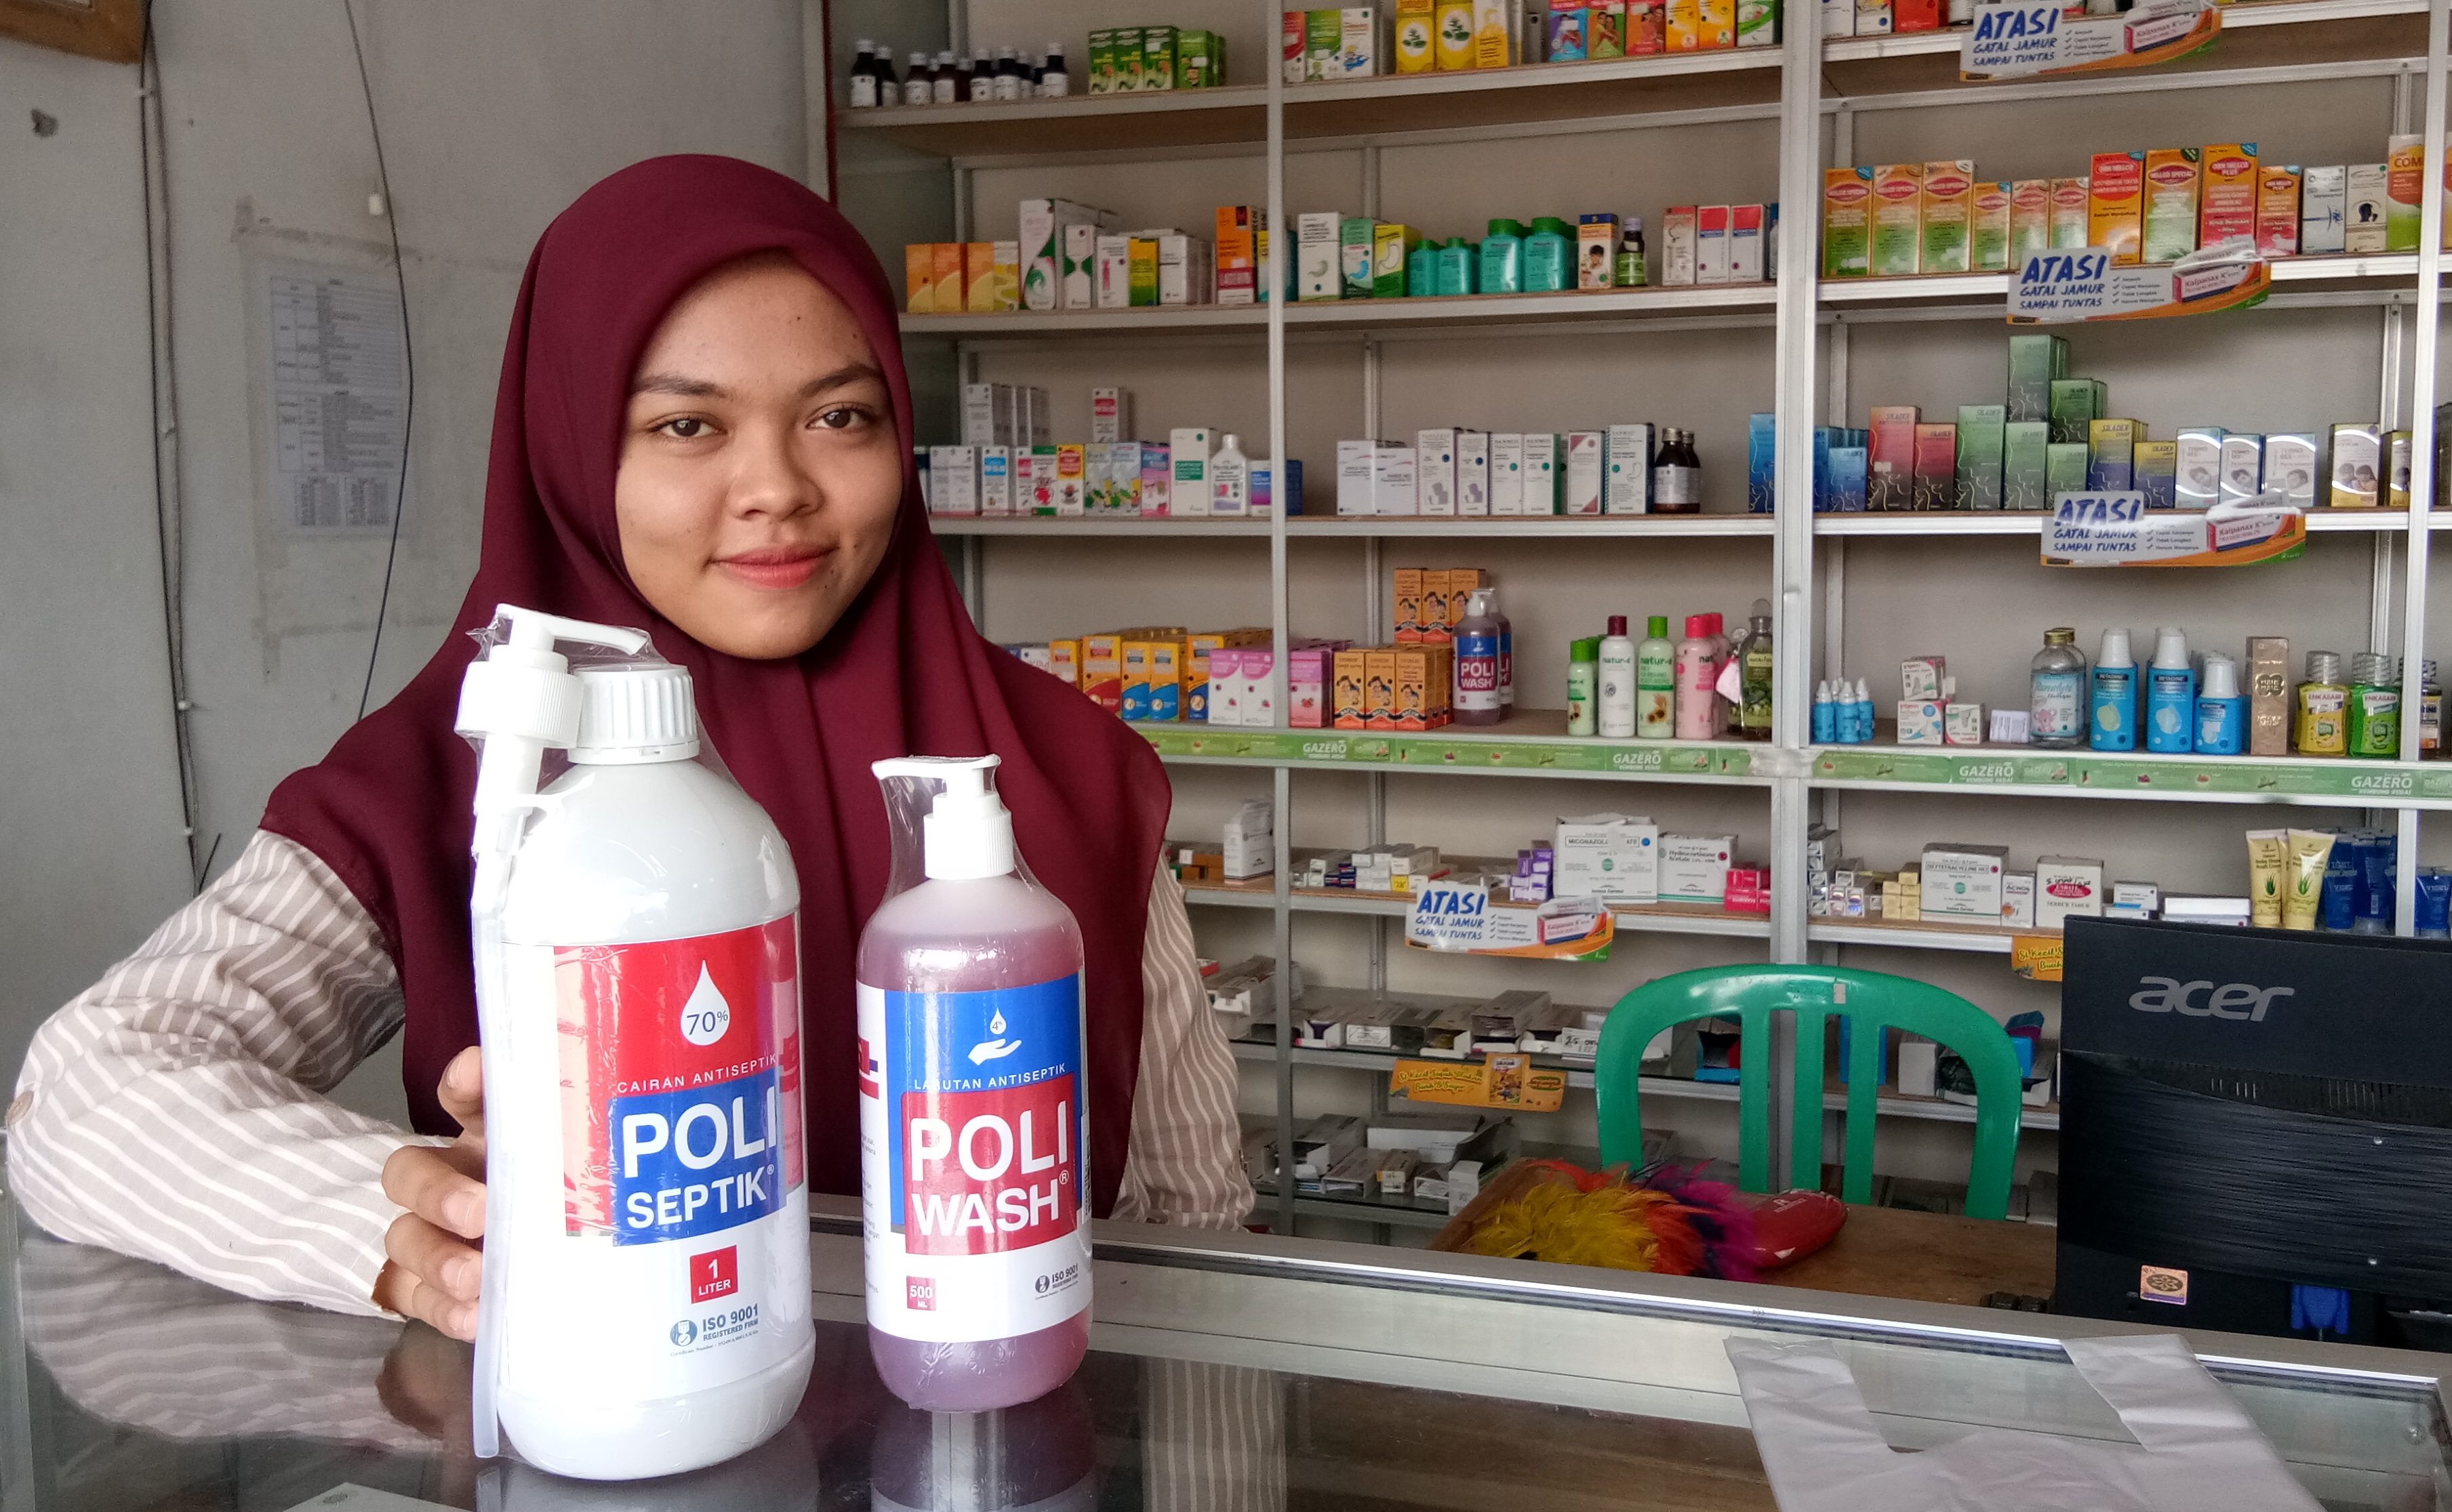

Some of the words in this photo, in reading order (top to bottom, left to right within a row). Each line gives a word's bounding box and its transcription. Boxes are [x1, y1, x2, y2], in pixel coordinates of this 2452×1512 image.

[1973, 8, 2059, 41] ATASI
[1973, 40, 2010, 54] GATAL
[2013, 37, 2058, 51] JAMUR
[1973, 55, 2011, 67] SAMPAI
[2014, 51, 2055, 63] TUNTAS
[2019, 254, 2107, 284] ATASI
[2019, 285, 2056, 297] GATAL
[2061, 283, 2105, 295] JAMUR
[2019, 299, 2059, 310] SAMPAI
[2062, 298, 2102, 308] TUNTAS
[2055, 498, 2139, 526] ATASI
[2053, 528, 2089, 539] GATAL
[2053, 542, 2091, 552] SAMPAI
[2095, 542, 2137, 552] TUNTAS
[1461, 661, 1494, 677] POLI
[1461, 678, 1492, 688] WASH
[1613, 752, 1661, 764] GAZERO
[1958, 765, 2014, 778] GAZERO
[2351, 776, 2413, 788] GAZERO
[1416, 890, 1486, 915] ATASI
[1449, 918, 1485, 928] JAMUR
[1449, 930, 1483, 940] TUNTAS
[2031, 947, 2055, 956] Kecil
[2128, 976, 2295, 1022] acer
[687, 1010, 728, 1035] 70%
[618, 1076, 685, 1093] CAIRAN
[693, 1053, 776, 1084] ANTISEPTIK
[988, 1063, 1066, 1086] ANTISEPTIK
[622, 1086, 777, 1178] POLI
[910, 1100, 1067, 1181] POLI
[708, 1259, 719, 1279] 1
[1052, 1271, 1064, 1283] ISO
[1066, 1263, 1078, 1277] 9001
[698, 1279, 731, 1296] LITER
[910, 1285, 933, 1299] 500
[702, 1314, 726, 1332] ISO
[730, 1303, 758, 1324] 9001
[703, 1325, 743, 1341] REGISTERED
[744, 1318, 759, 1329] FIRM
